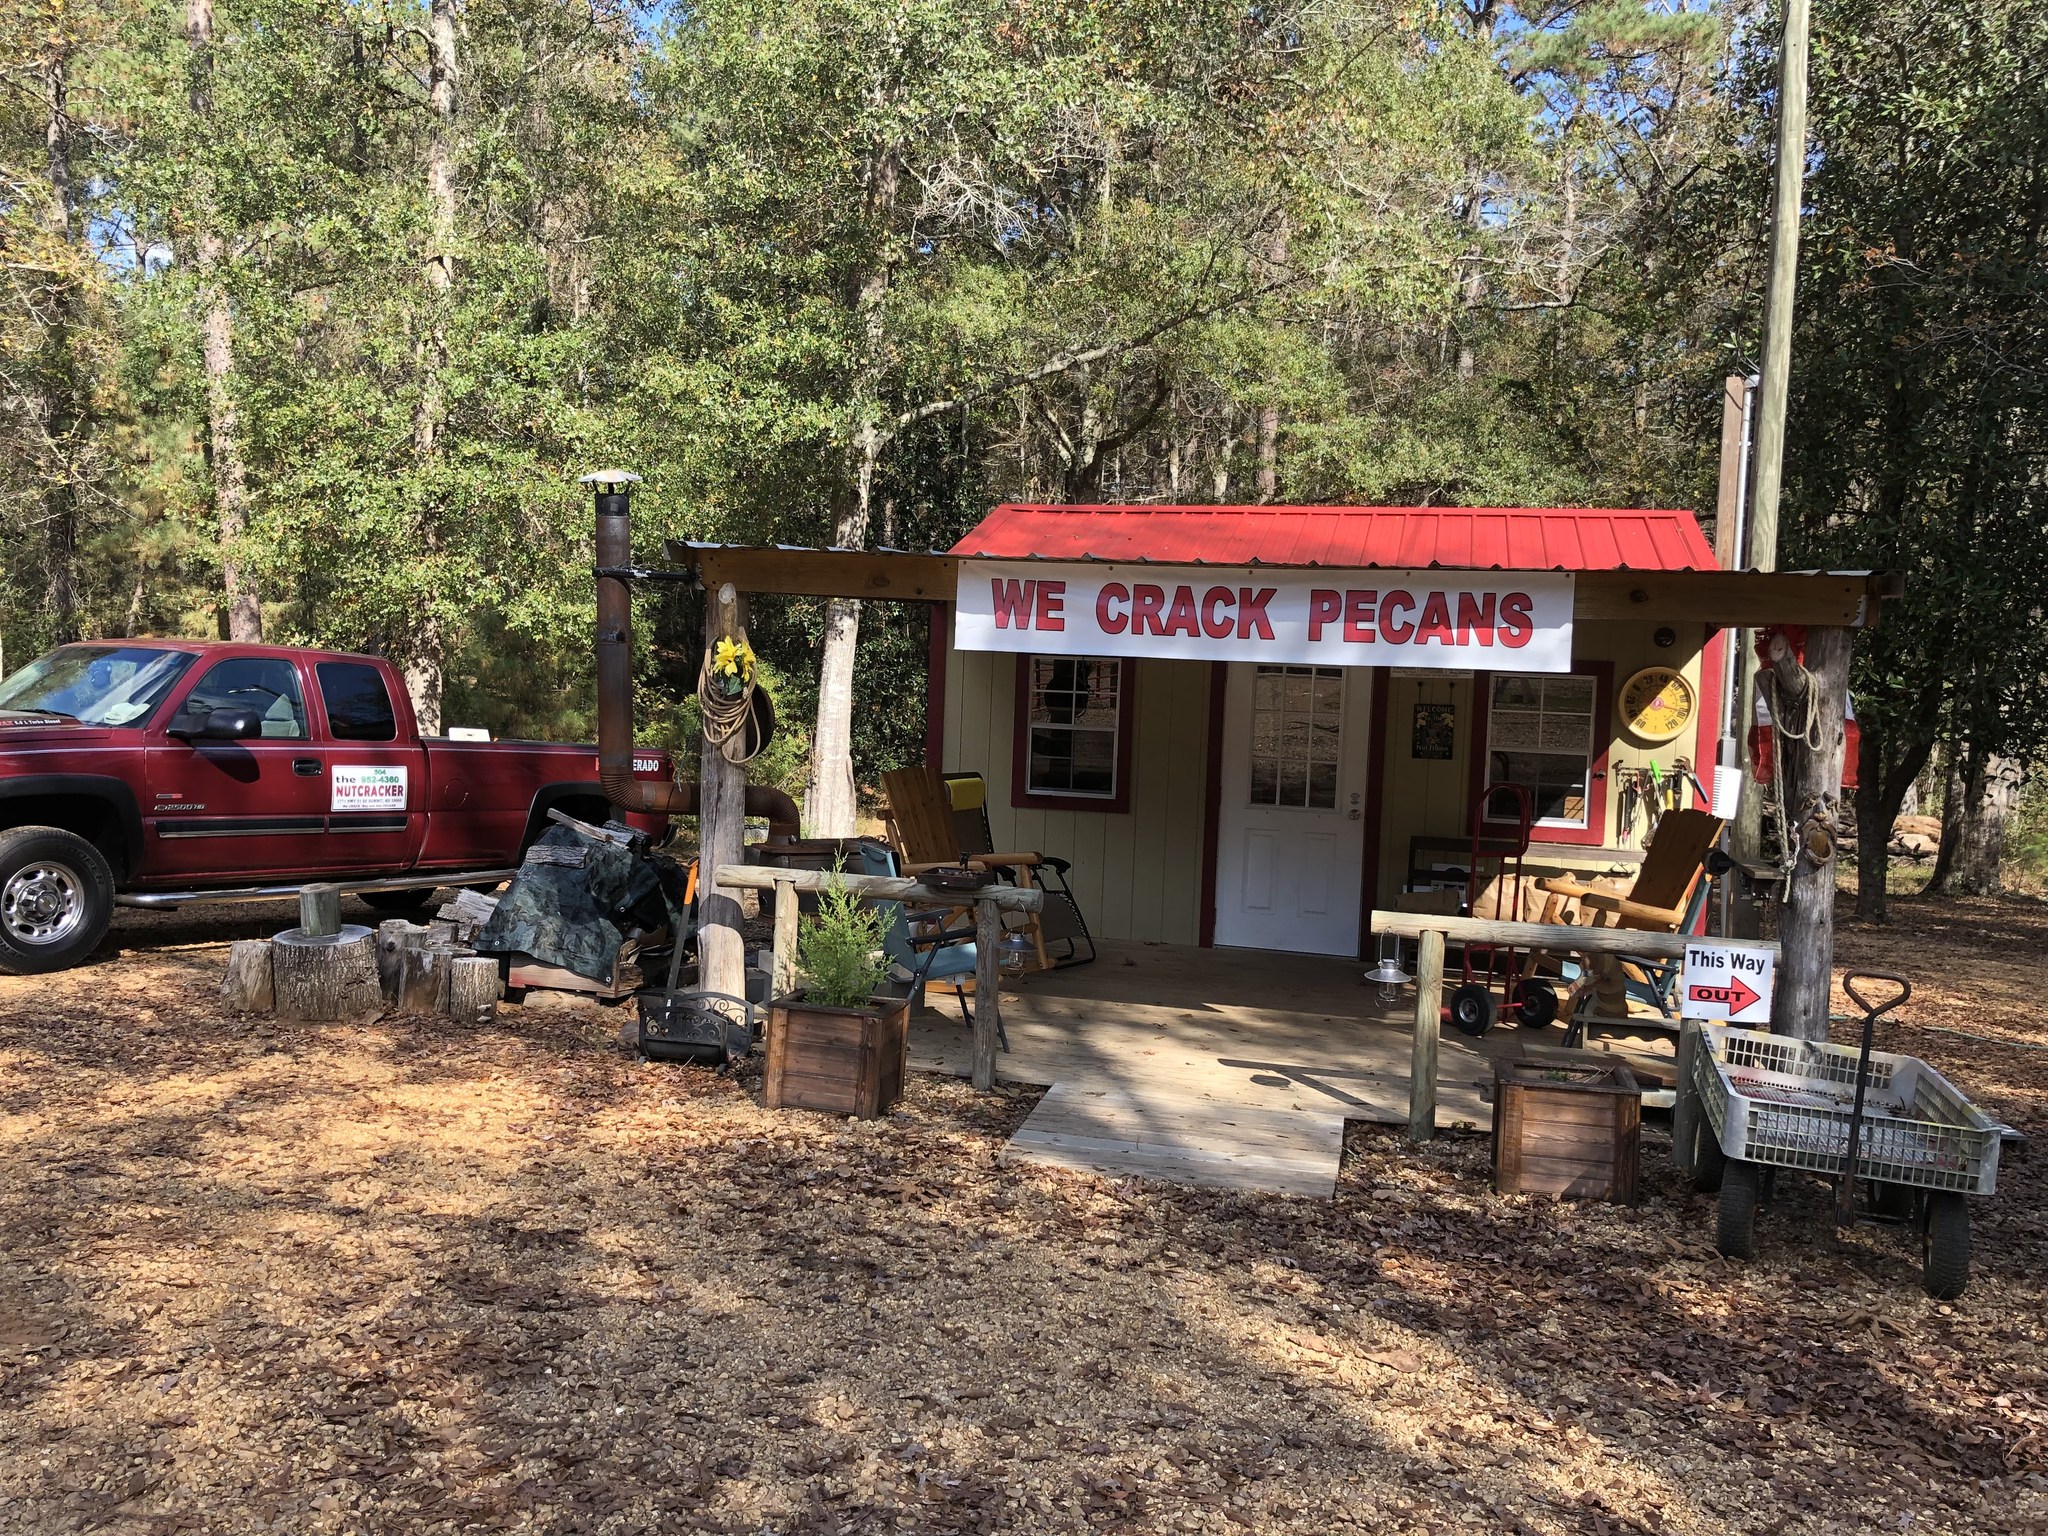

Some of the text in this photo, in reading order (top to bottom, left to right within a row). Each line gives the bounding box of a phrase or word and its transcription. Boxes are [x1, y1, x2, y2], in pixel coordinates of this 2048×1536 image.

[990, 578, 1535, 649] WE CRACK PECANS
[1676, 708, 1688, 719] 100
[1665, 719, 1679, 731] 120
[633, 759, 659, 771] ERADO
[336, 775, 356, 783] the
[336, 785, 404, 797] NUTCRACKER
[1689, 950, 1766, 975] This Way
[1697, 989, 1746, 1002] OUT
